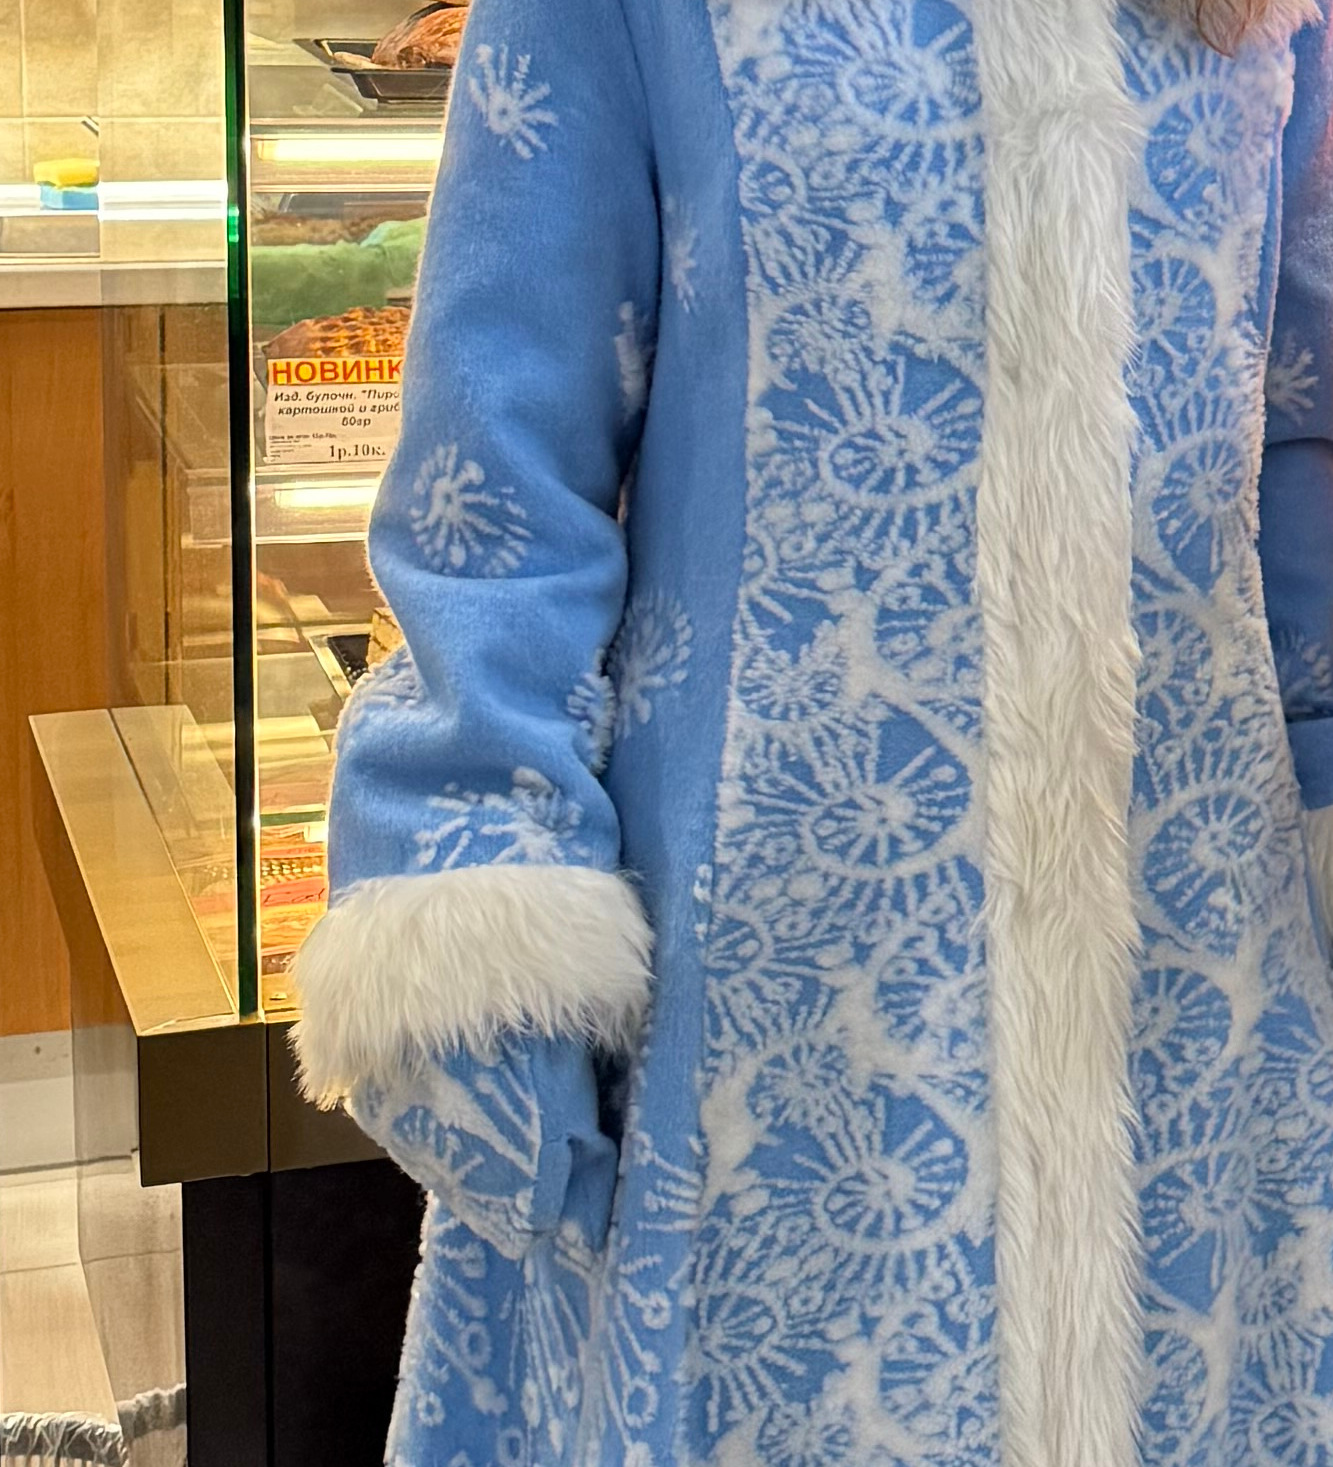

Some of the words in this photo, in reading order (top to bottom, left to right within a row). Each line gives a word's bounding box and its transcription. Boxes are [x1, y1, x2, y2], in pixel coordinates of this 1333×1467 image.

[272, 360, 404, 383] НОВИНК
[274, 391, 302, 402] Изд.
[306, 390, 357, 403] булочн.
[361, 389, 400, 400] "Пиро
[370, 402, 400, 414] гриб
[329, 444, 386, 460] 1р.10к.
